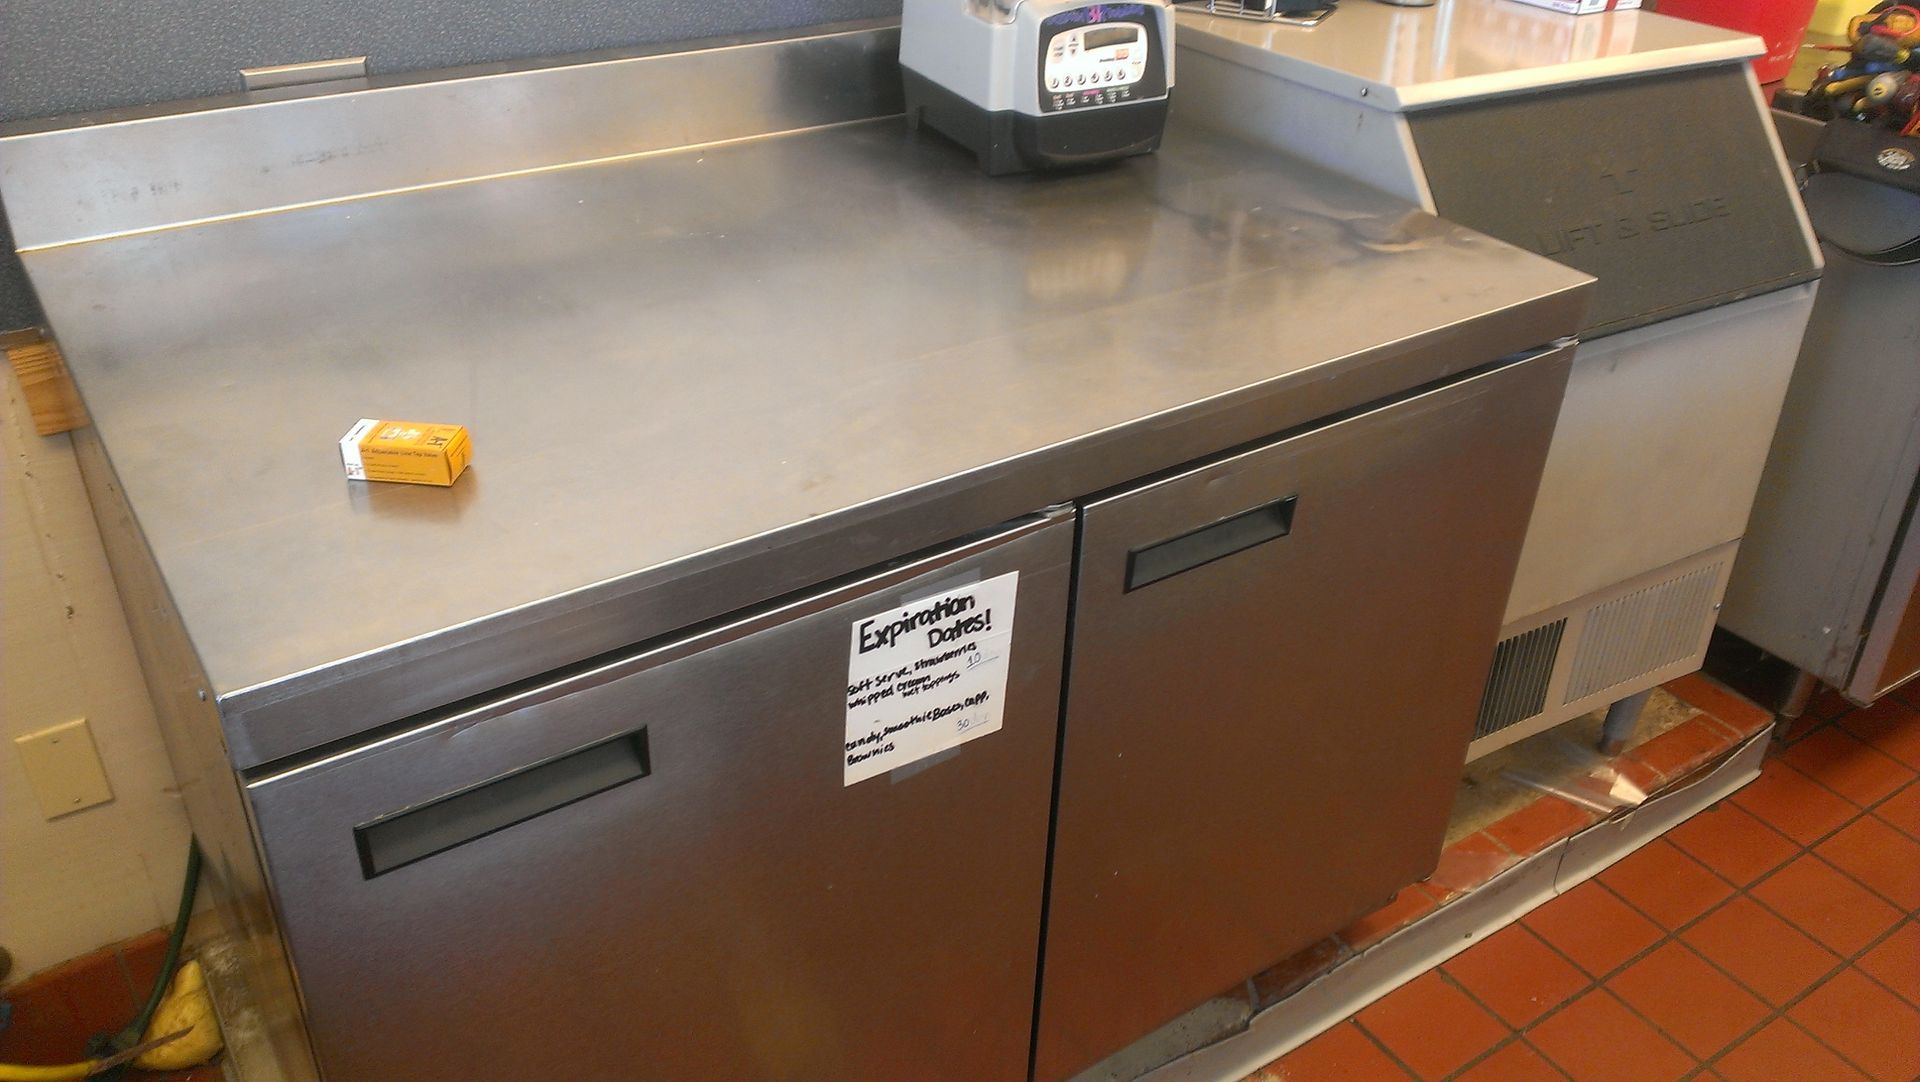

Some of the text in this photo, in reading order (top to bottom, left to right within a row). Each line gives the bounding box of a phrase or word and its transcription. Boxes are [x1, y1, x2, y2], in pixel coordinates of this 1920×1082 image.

[1537, 197, 1731, 257] LIFT & SLIDE
[858, 594, 976, 655] Expiration
[927, 608, 992, 649] Dates!
[848, 686, 894, 710] whipped
